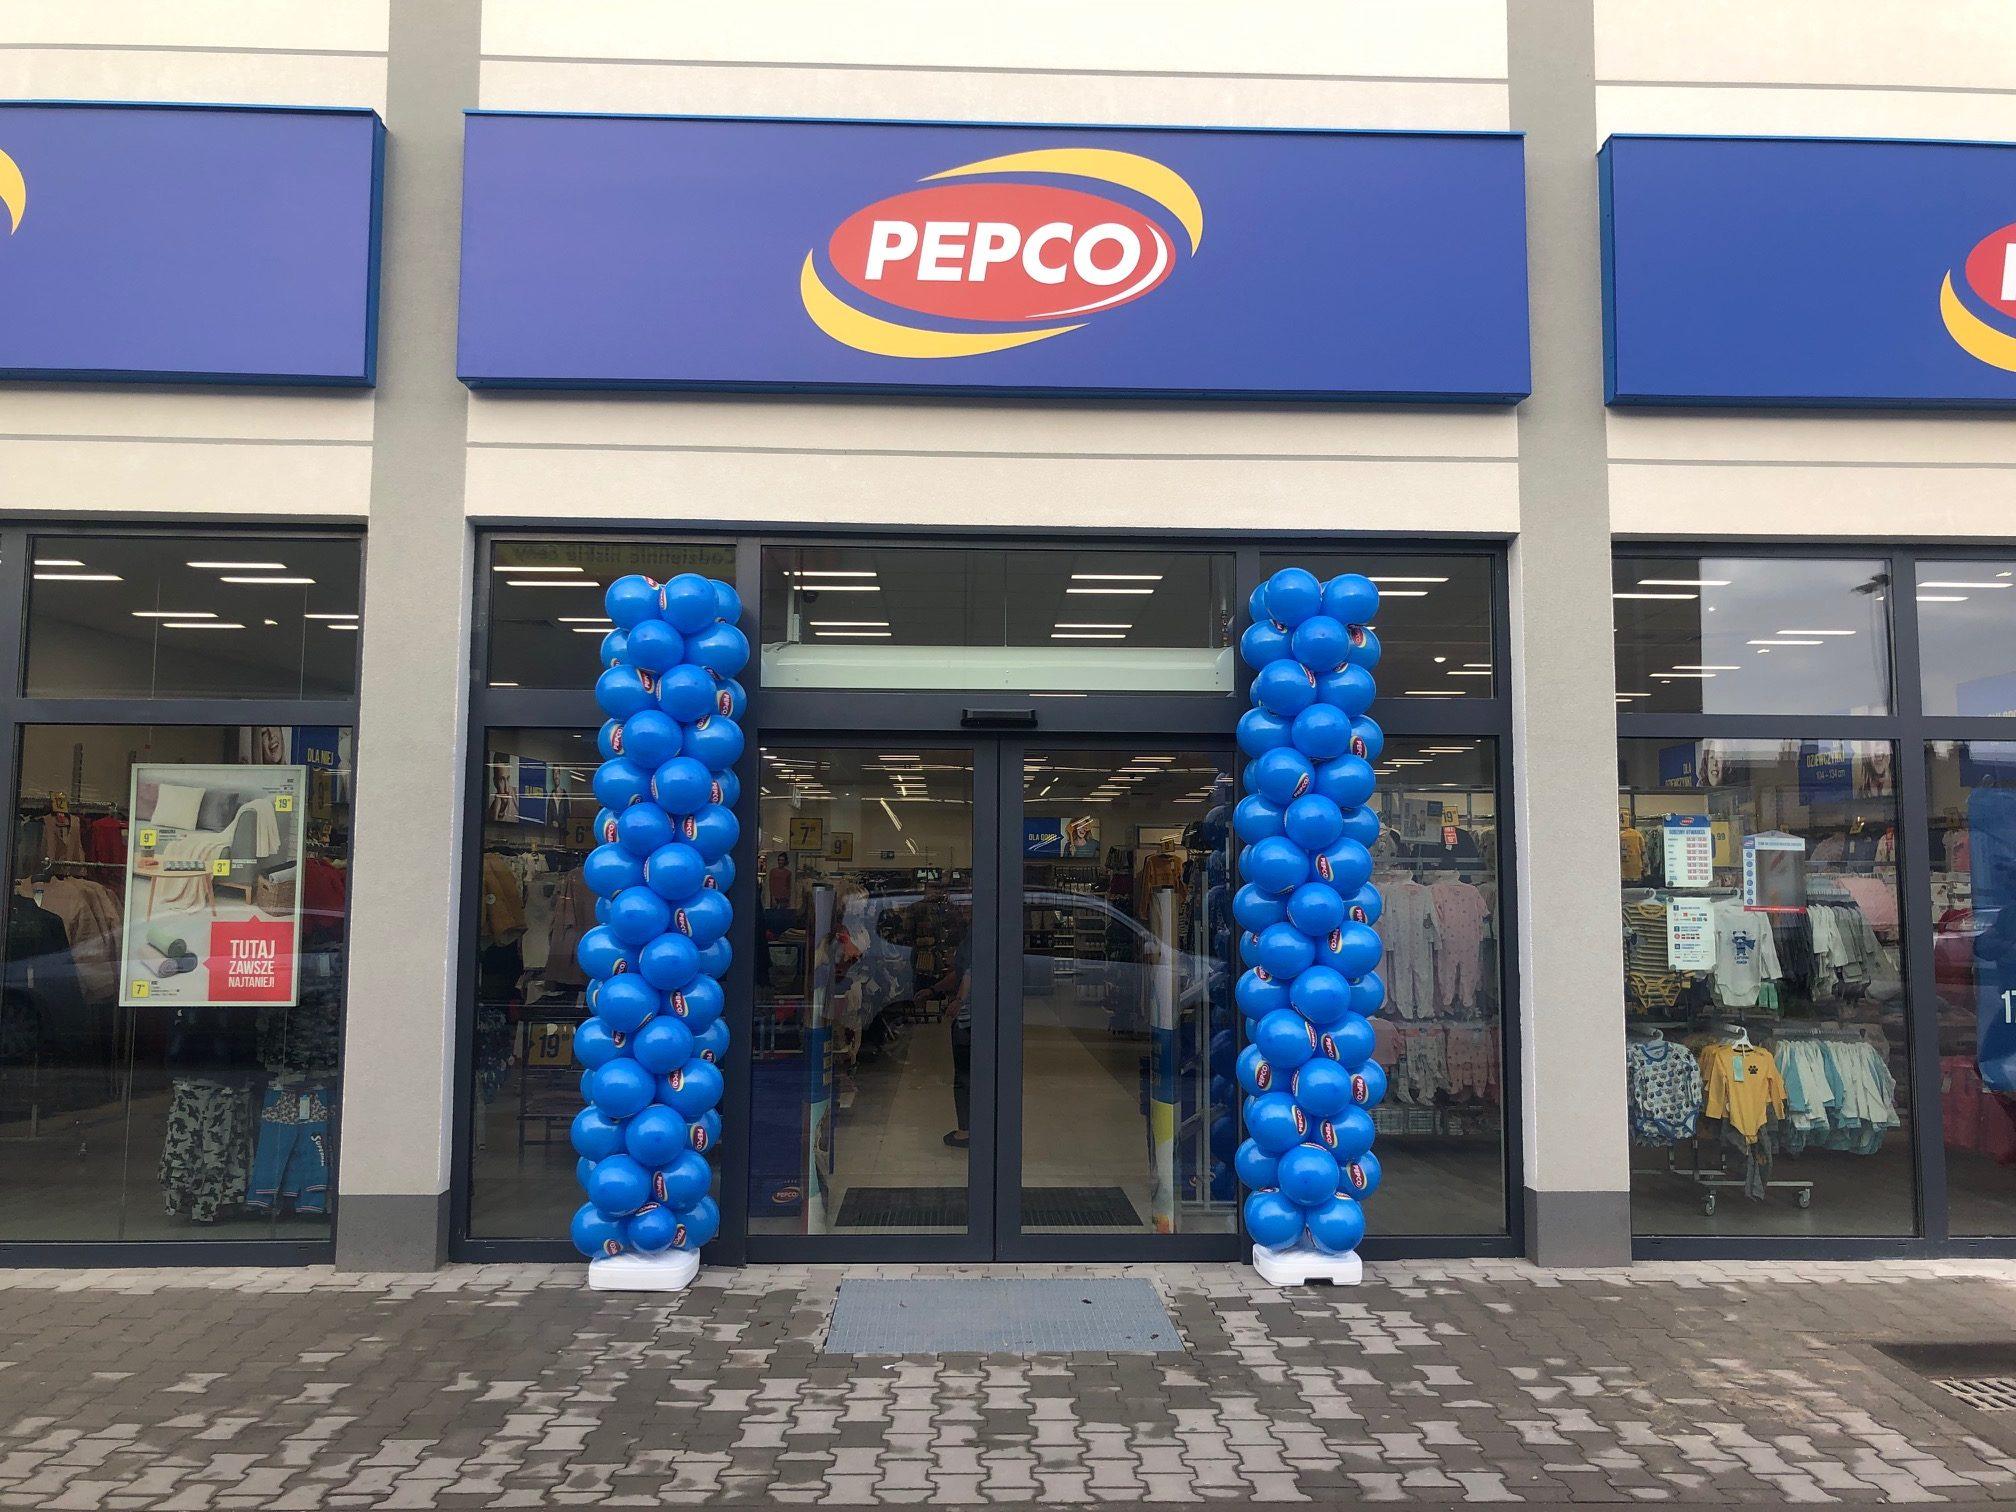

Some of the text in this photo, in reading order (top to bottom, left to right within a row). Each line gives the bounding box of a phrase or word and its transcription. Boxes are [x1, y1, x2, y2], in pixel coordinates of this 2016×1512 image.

[865, 220, 1141, 286] PEPCO
[230, 939, 276, 959] TUTAJ
[229, 960, 275, 975] ZAWSZE
[228, 976, 275, 988] NAJTANIEJ!
[539, 1033, 560, 1058] 19
[1258, 1065, 1268, 1087] PEPCO
[1356, 1078, 1364, 1101] PEPCO
[1352, 1164, 1363, 1186] PEPCO
